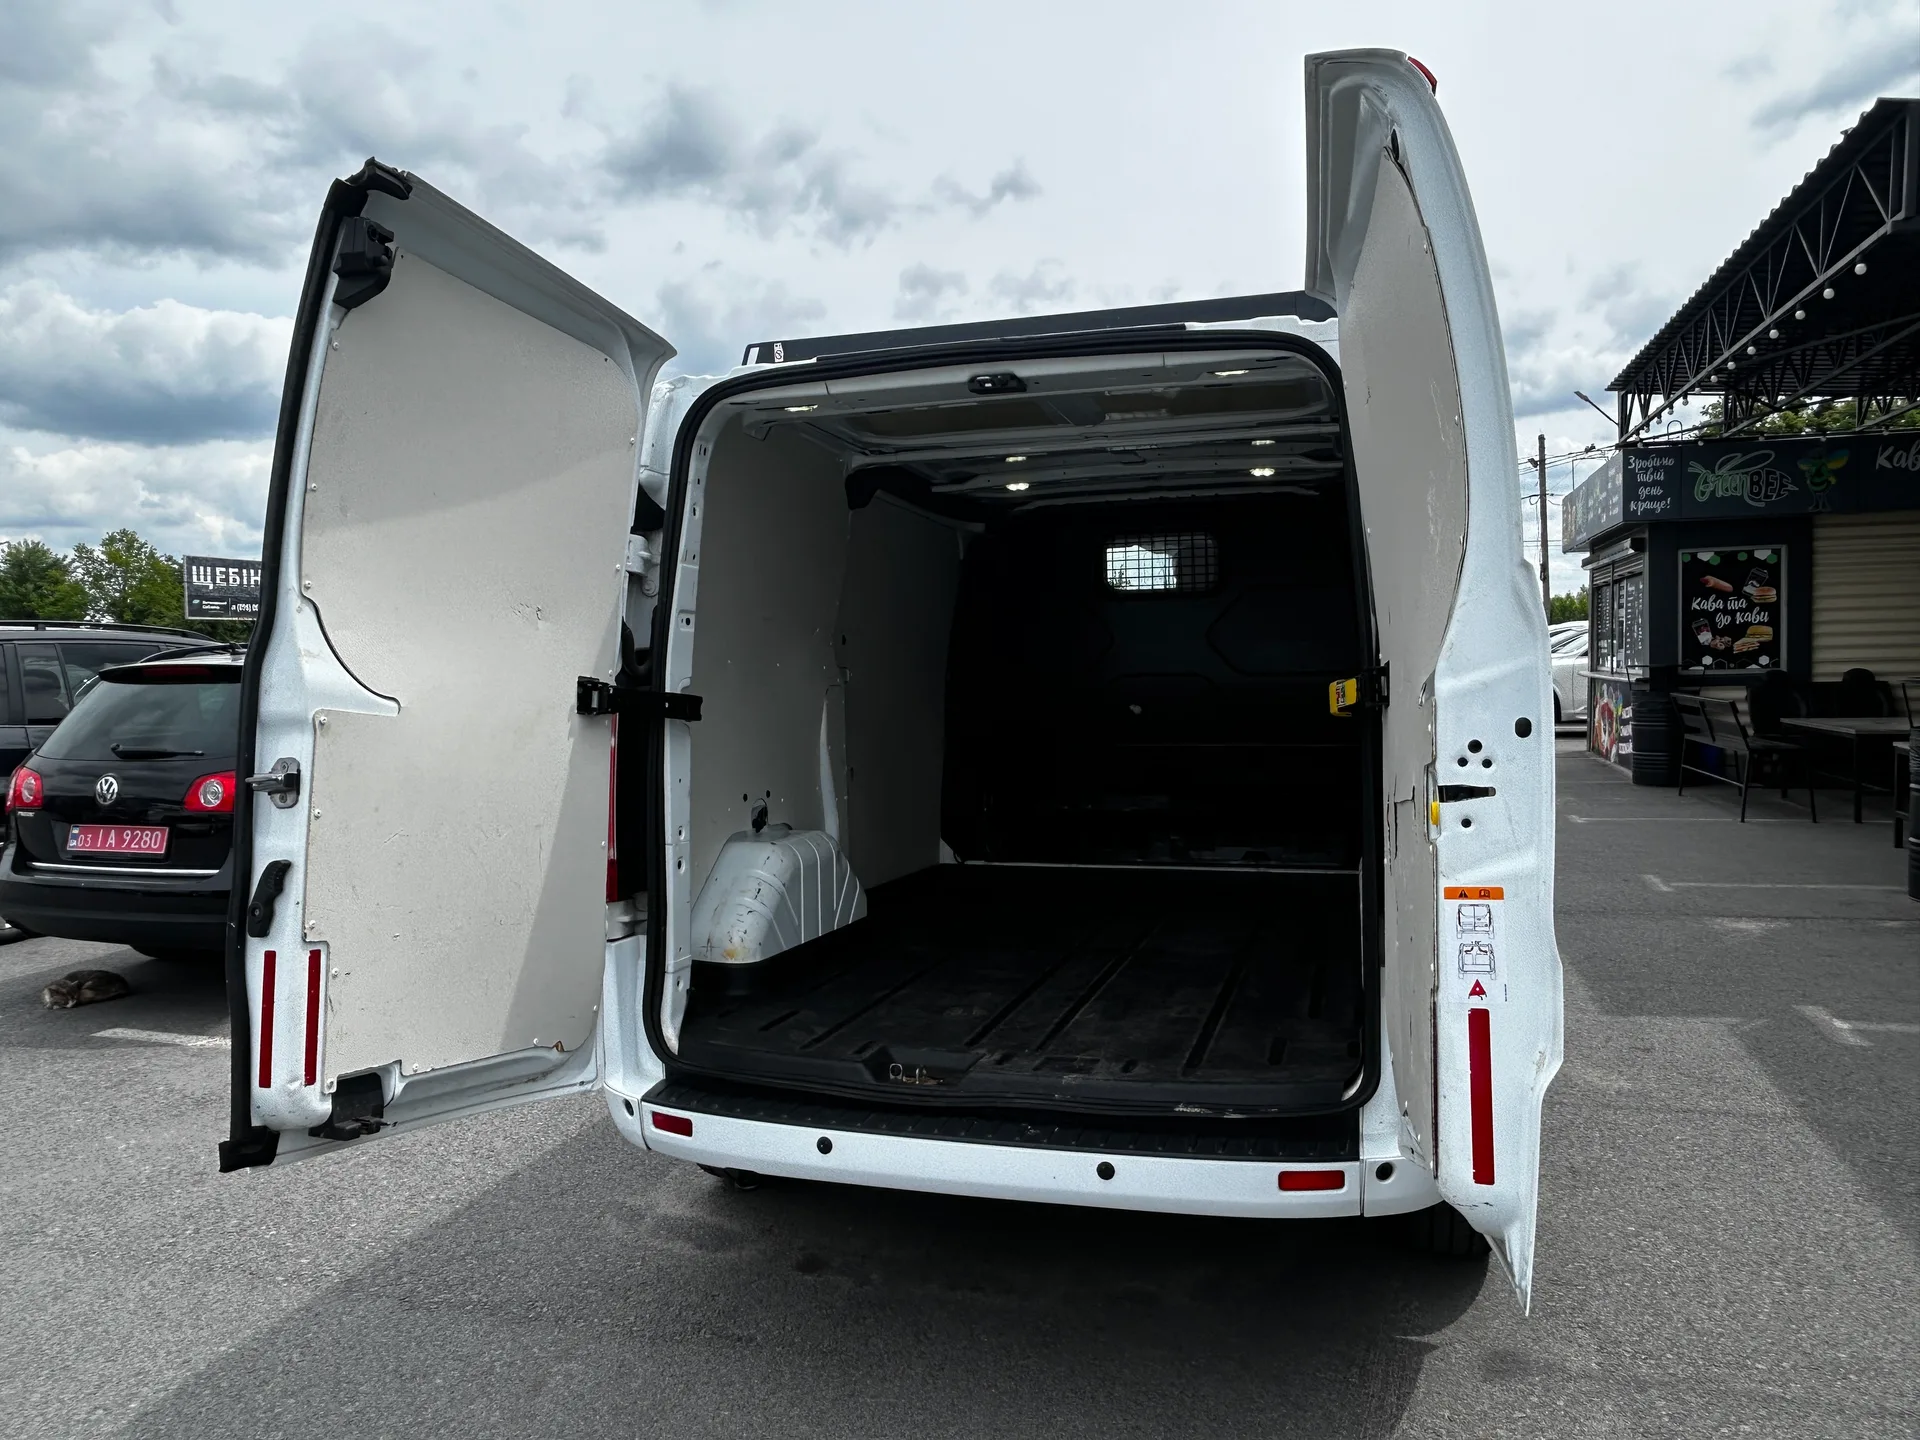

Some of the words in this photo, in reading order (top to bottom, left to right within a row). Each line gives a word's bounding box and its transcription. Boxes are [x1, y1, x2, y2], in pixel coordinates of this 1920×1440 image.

[1627, 454, 1675, 473] Зробимо
[1637, 468, 1664, 482] твій
[1638, 485, 1664, 500] день
[1630, 497, 1671, 516] краще!
[1691, 594, 1725, 612] Кава
[1727, 596, 1748, 610] та
[1715, 612, 1732, 629] до
[1735, 606, 1770, 624] кави
[121, 830, 162, 849] 9280
